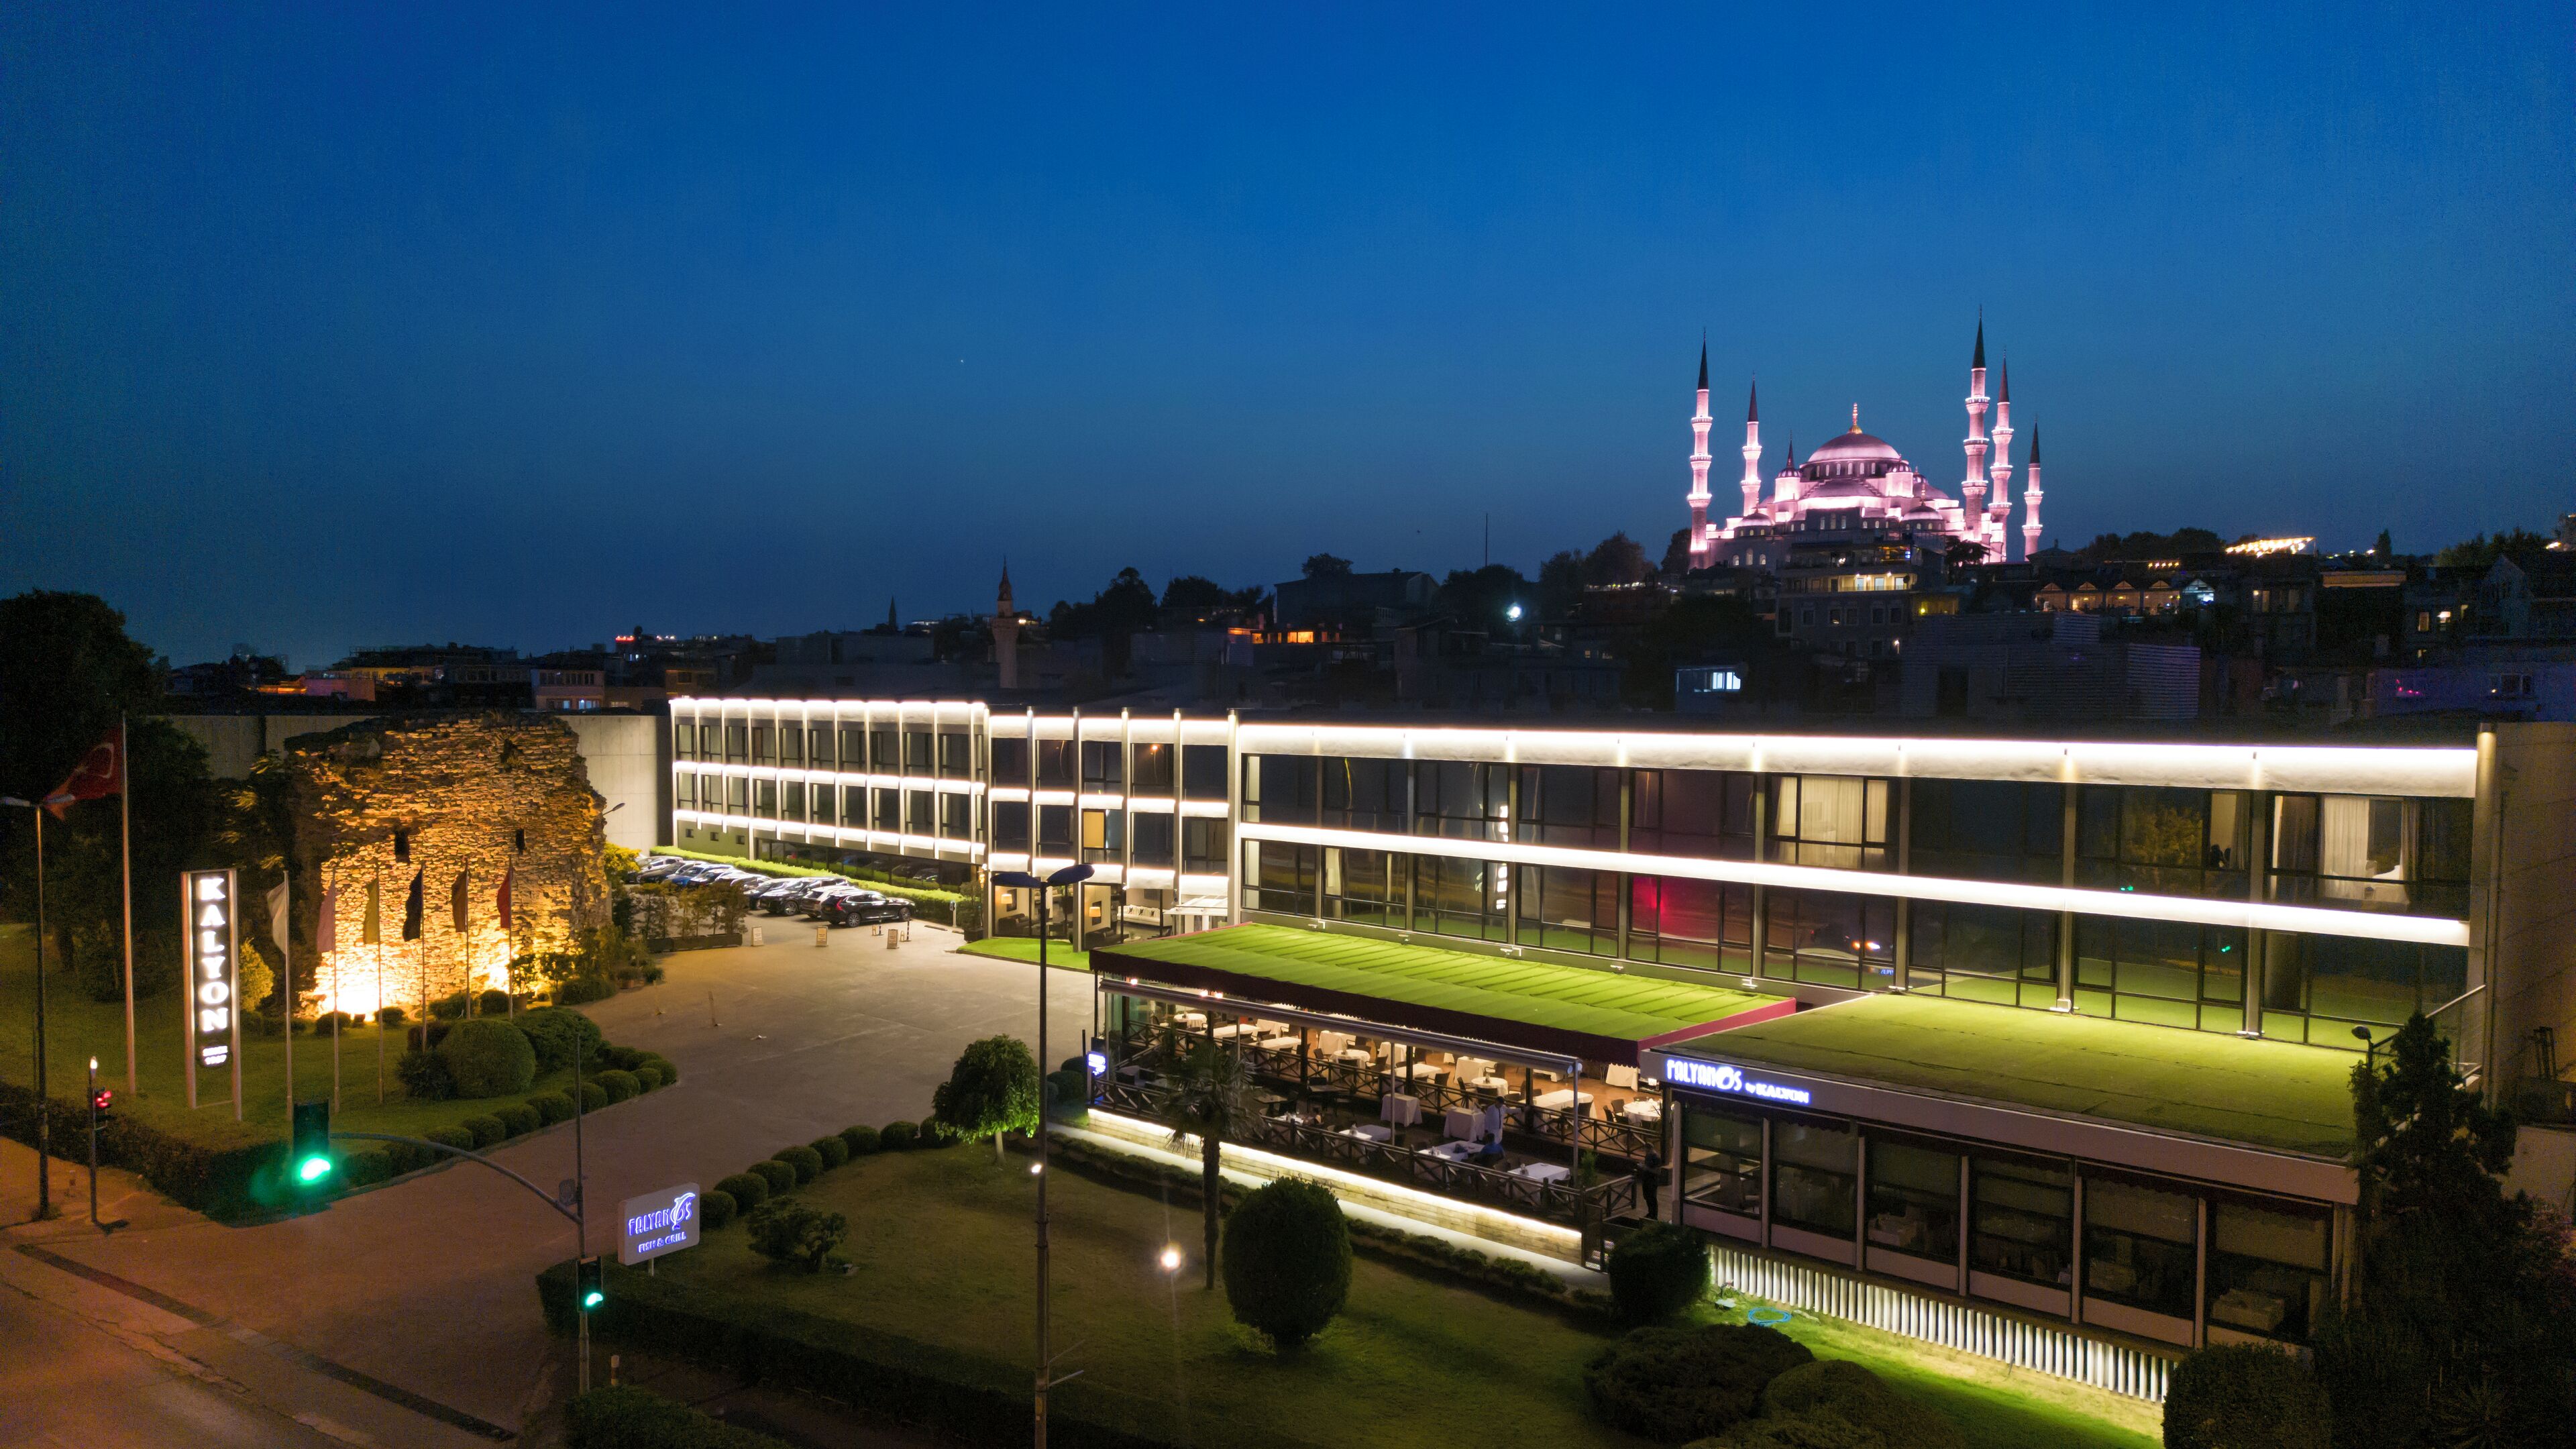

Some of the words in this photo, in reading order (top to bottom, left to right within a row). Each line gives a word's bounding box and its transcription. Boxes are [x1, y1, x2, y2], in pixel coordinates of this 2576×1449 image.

[200, 878, 229, 1032] KALYON
[639, 1240, 656, 1252] FISH
[665, 1231, 686, 1244] GRILL
